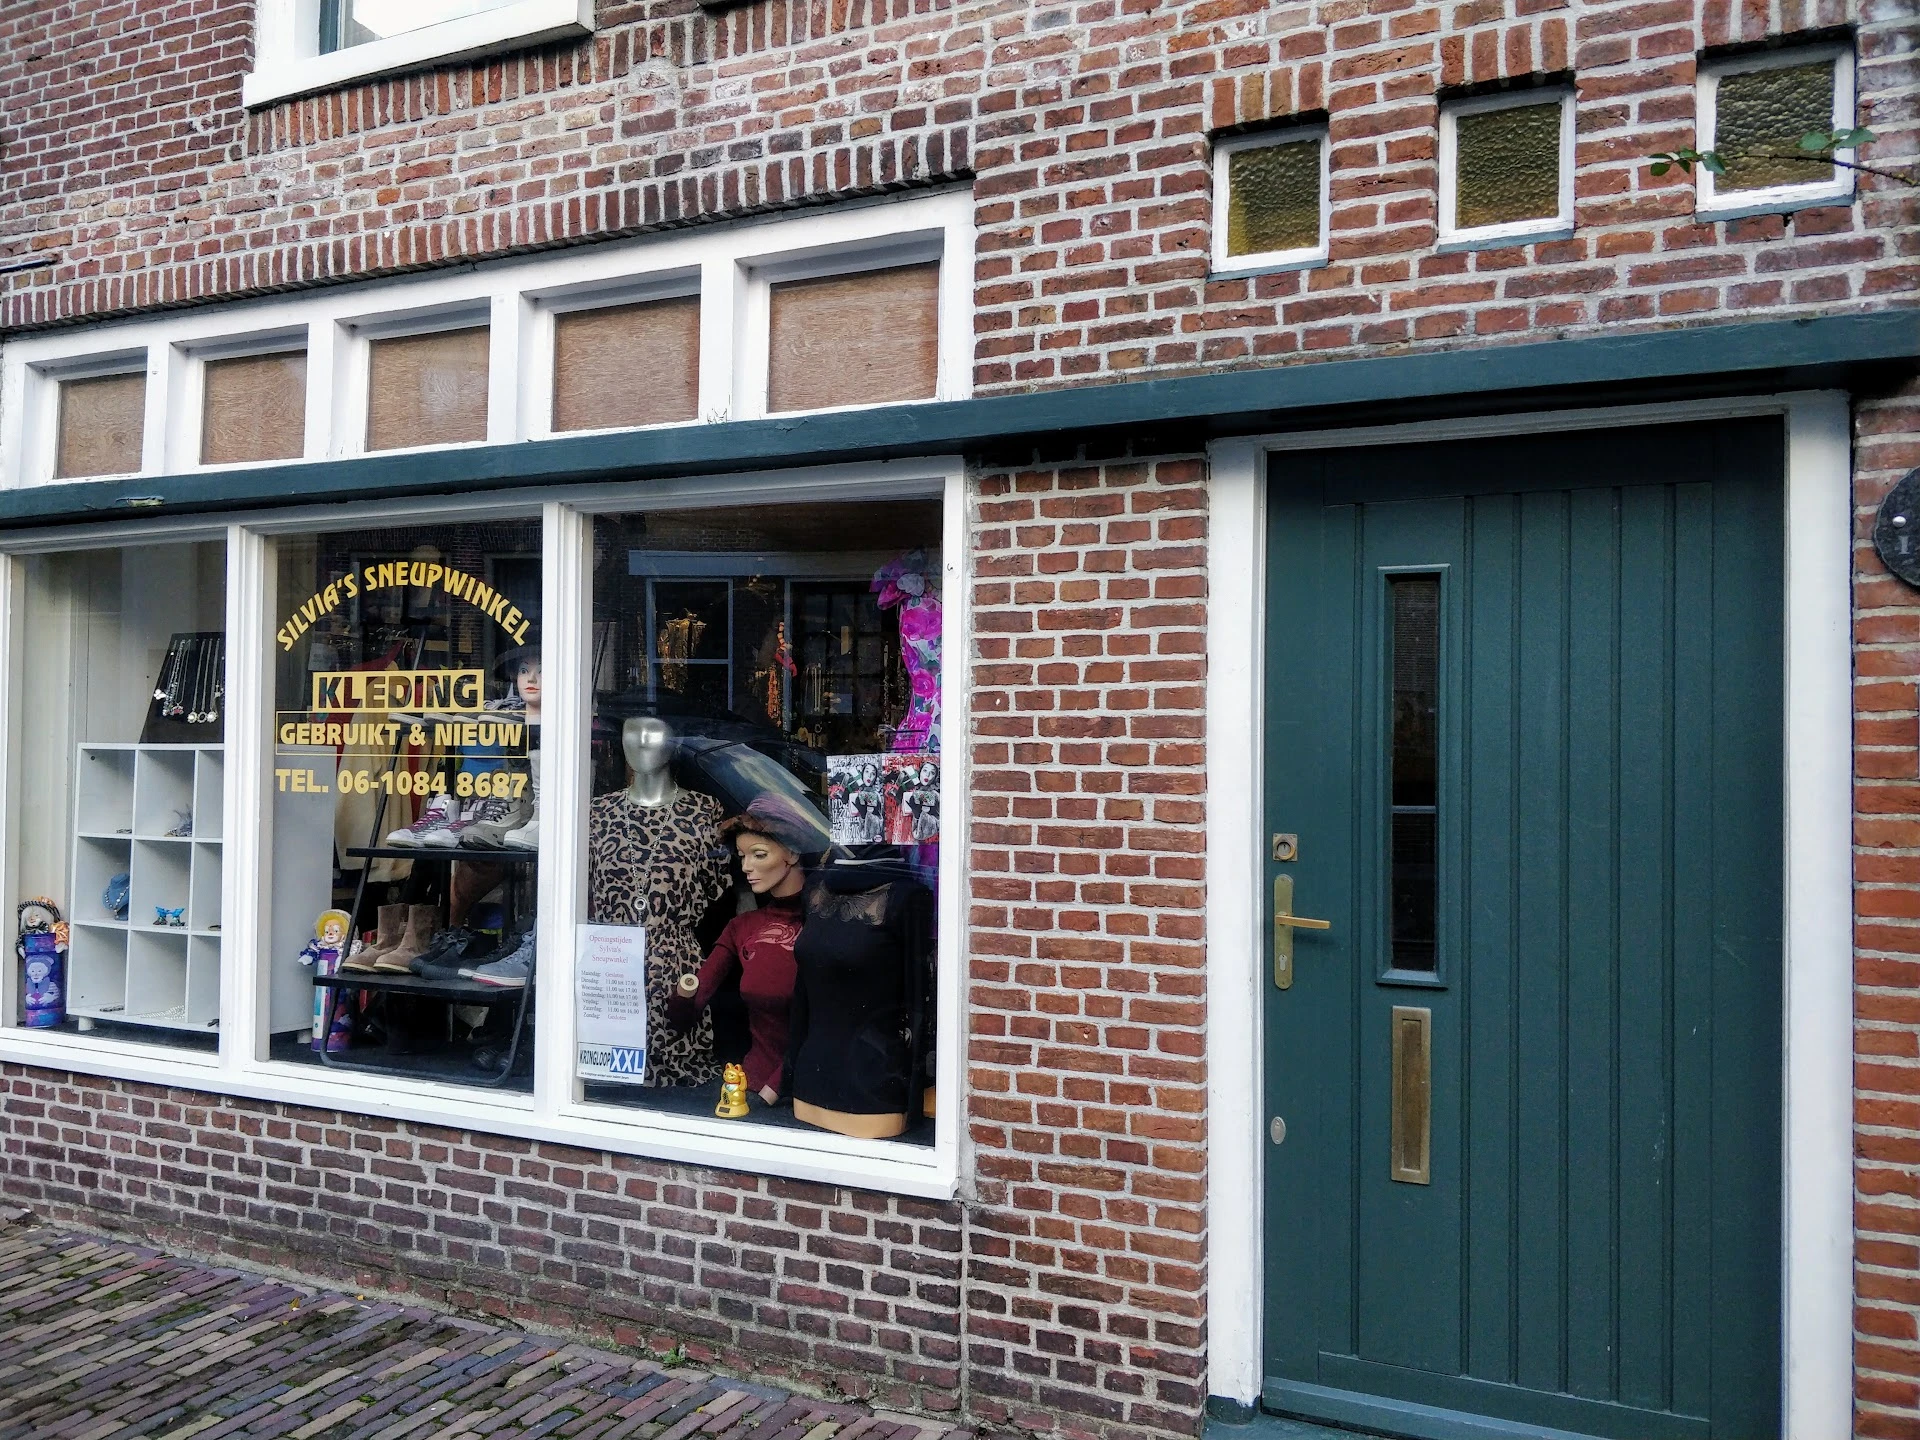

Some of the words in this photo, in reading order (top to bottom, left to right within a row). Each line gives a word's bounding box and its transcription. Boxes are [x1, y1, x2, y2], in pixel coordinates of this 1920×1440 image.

[277, 573, 358, 651] SILVIA'S
[364, 561, 531, 646] SNEUPWINKEL
[318, 674, 478, 709] KLEDING
[280, 722, 400, 745] GEBRUIKT
[409, 725, 426, 746] &
[435, 723, 522, 747] NIEUW
[275, 768, 329, 793] TEL.
[338, 770, 447, 796] 06-1084
[456, 773, 528, 798] 8687
[589, 935, 632, 944] Openingstijden
[610, 1049, 643, 1073] XXL
